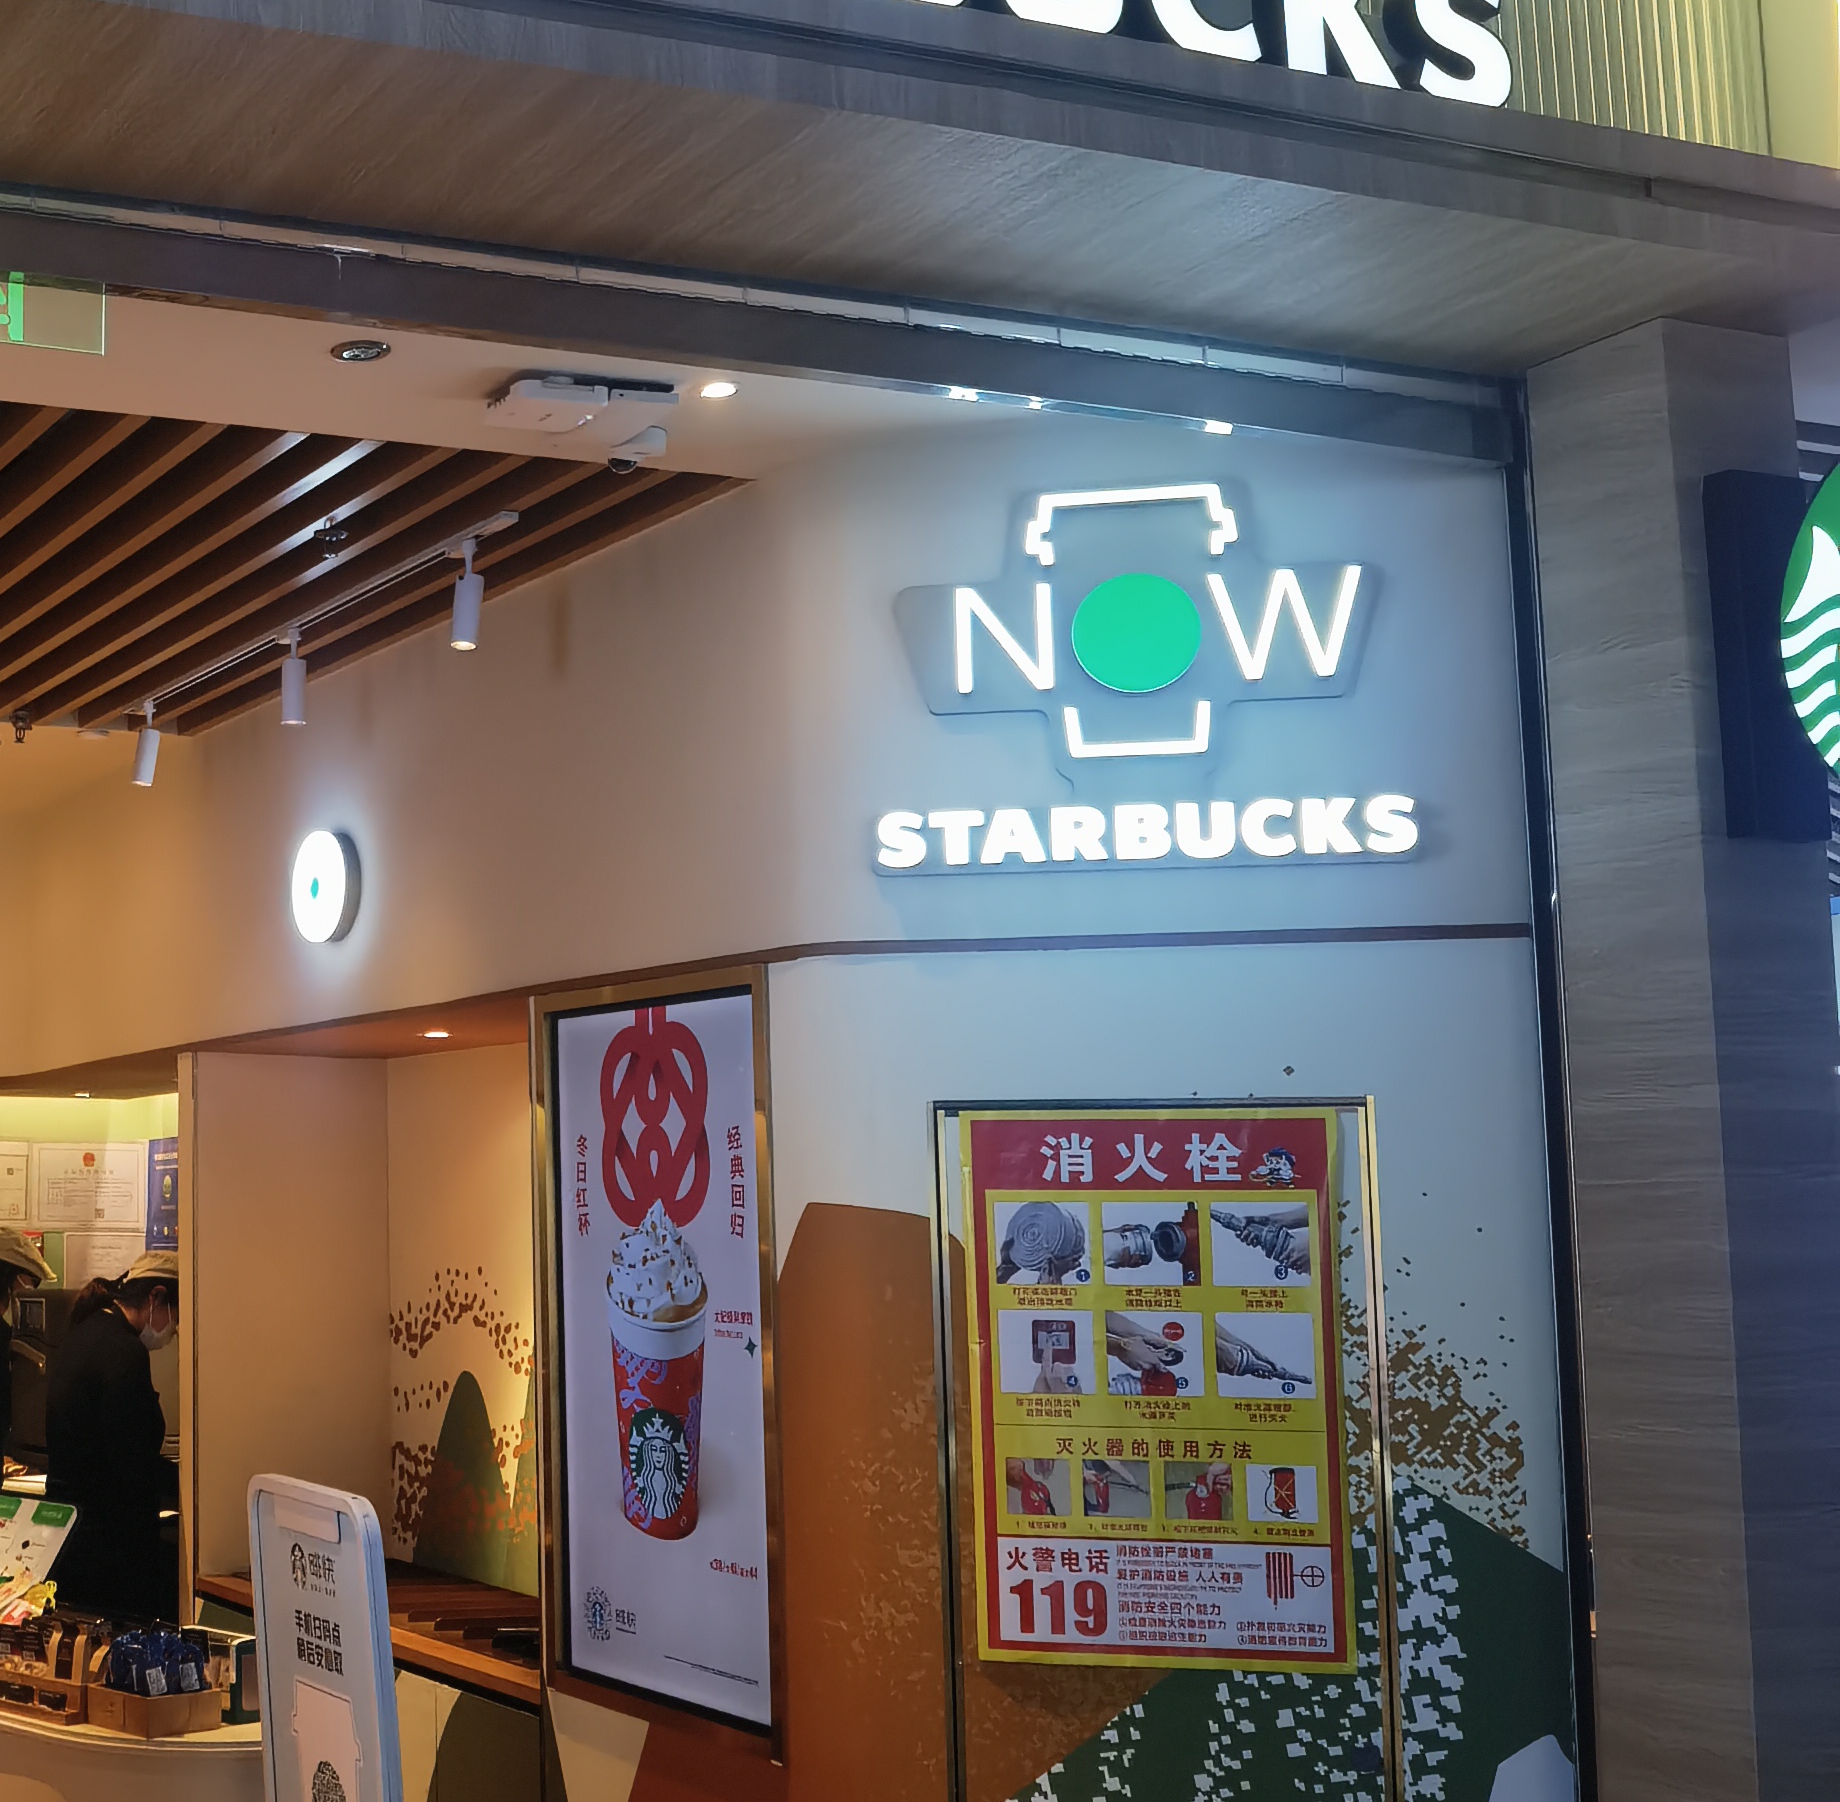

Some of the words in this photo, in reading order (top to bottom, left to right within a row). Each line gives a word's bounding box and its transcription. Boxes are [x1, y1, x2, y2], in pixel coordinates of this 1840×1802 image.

[876, 794, 1419, 869] STARBUCKS
[727, 1125, 745, 1238] 经典回归
[1039, 1132, 1243, 1184] 消火栓
[576, 1134, 591, 1237] 冬日红杯
[1056, 1437, 1252, 1460] 灭火器的使用方法
[1006, 1545, 1111, 1574] 火警电话
[1196, 1570, 1244, 1585] 人人有责
[1009, 1578, 1108, 1637] 119
[1118, 1600, 1221, 1616] 消防安全四个能力
